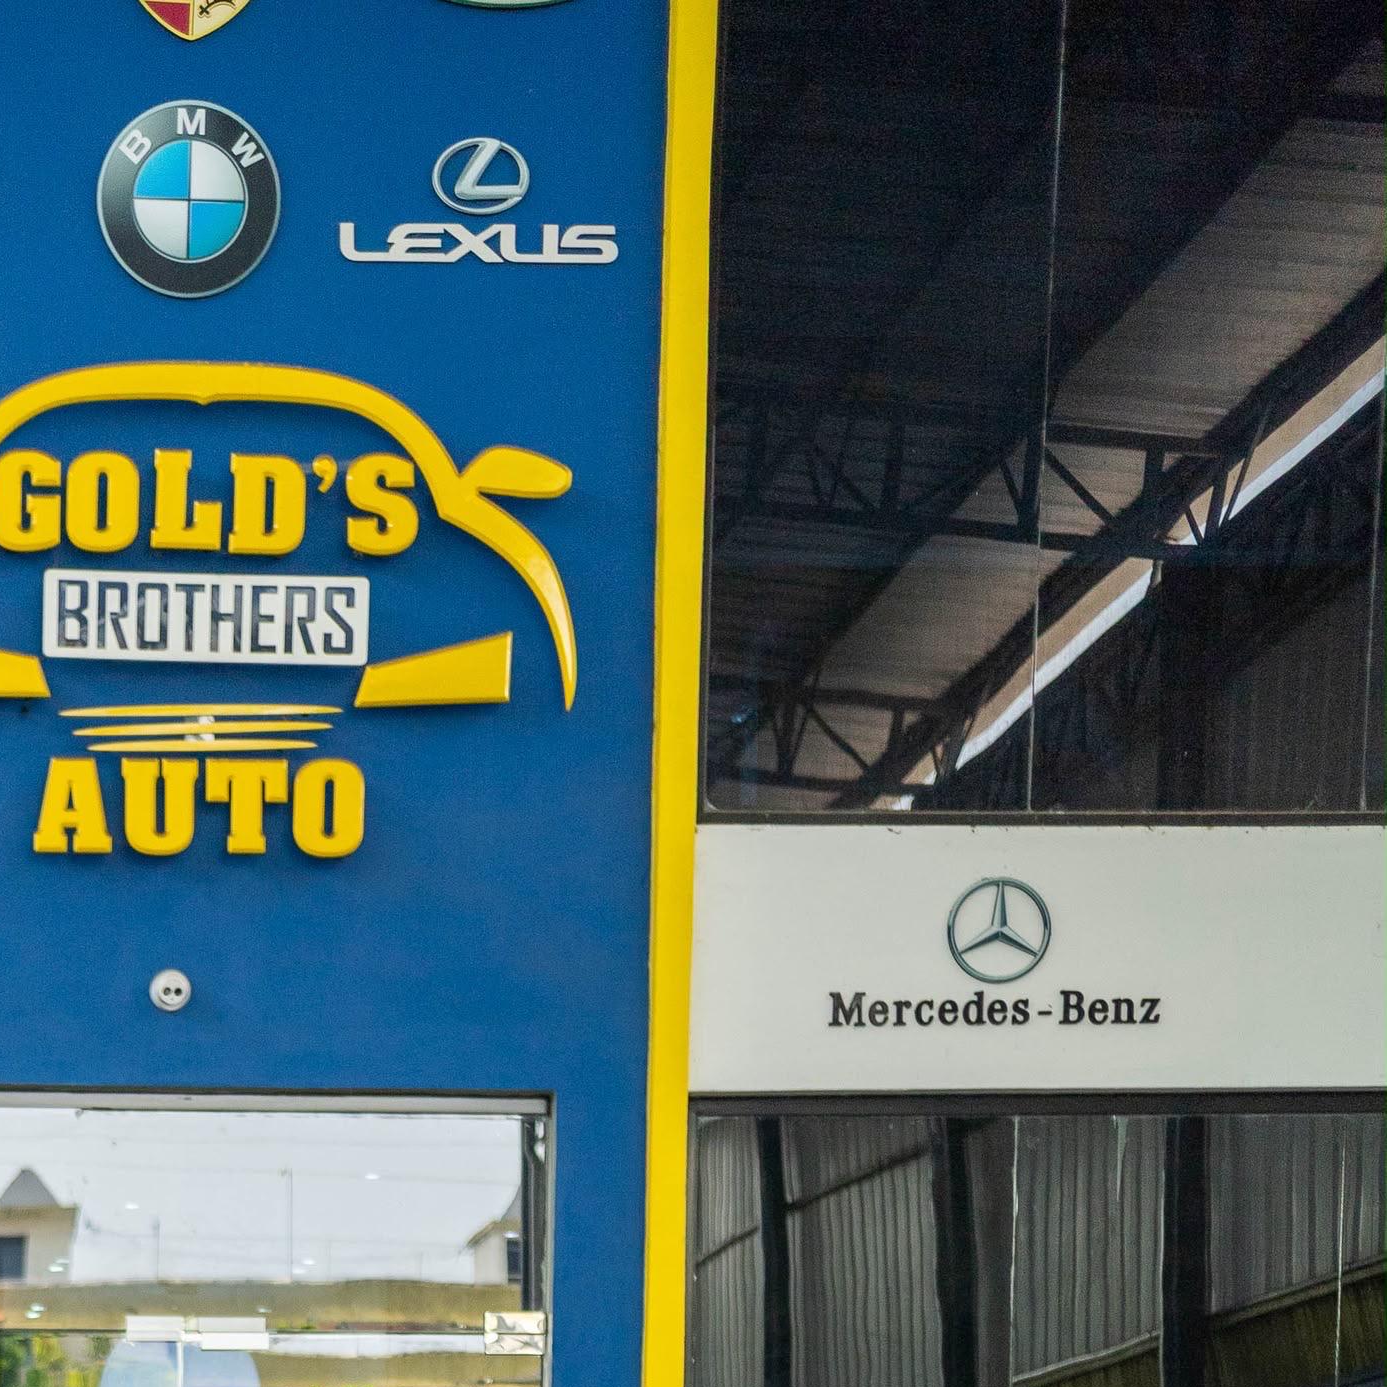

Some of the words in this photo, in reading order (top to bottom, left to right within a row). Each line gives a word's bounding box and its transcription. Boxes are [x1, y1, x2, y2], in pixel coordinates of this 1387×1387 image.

[118, 107, 266, 168] BMW
[339, 222, 619, 264] LEXUS
[56, 577, 356, 656] BROTHERS
[33, 757, 366, 858] AUTO
[827, 989, 1162, 1028] Mercedes-Benz
